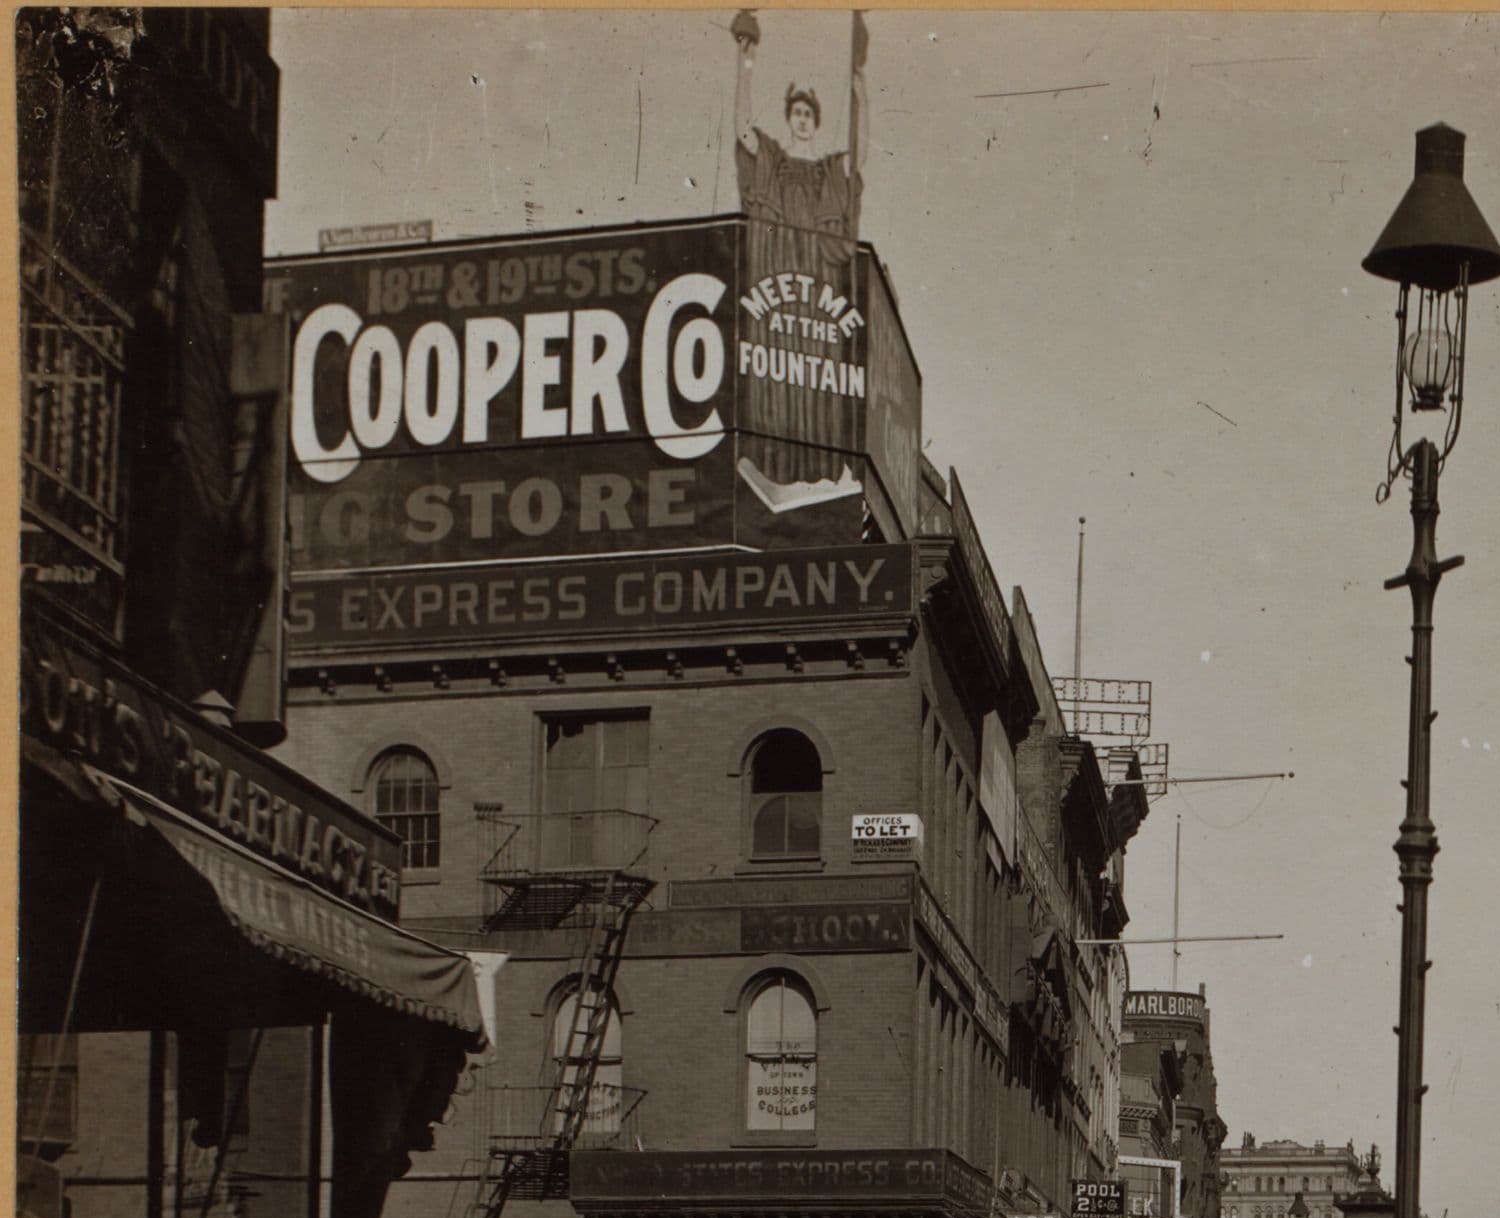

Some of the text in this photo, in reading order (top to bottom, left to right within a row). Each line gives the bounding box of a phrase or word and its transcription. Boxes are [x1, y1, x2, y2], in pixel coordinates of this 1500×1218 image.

[367, 247, 658, 315] 18TH & 19TH STS.
[740, 272, 865, 338] MEET ME
[769, 311, 838, 344] AT THE
[739, 341, 866, 399] FOUNTAIN
[291, 303, 630, 484] COOPER
[288, 467, 697, 551] IG STORE
[341, 574, 588, 631] EXPRESS
[614, 557, 895, 617] COMPANY.
[855, 825, 911, 837] TO LET
[863, 816, 903, 825] OFFICES
[757, 1086, 817, 1096] BUSINESS
[759, 1100, 817, 1117] COLLEGE
[776, 1157, 889, 1190] EXPRESS
[1075, 1183, 1120, 1198] POOL
